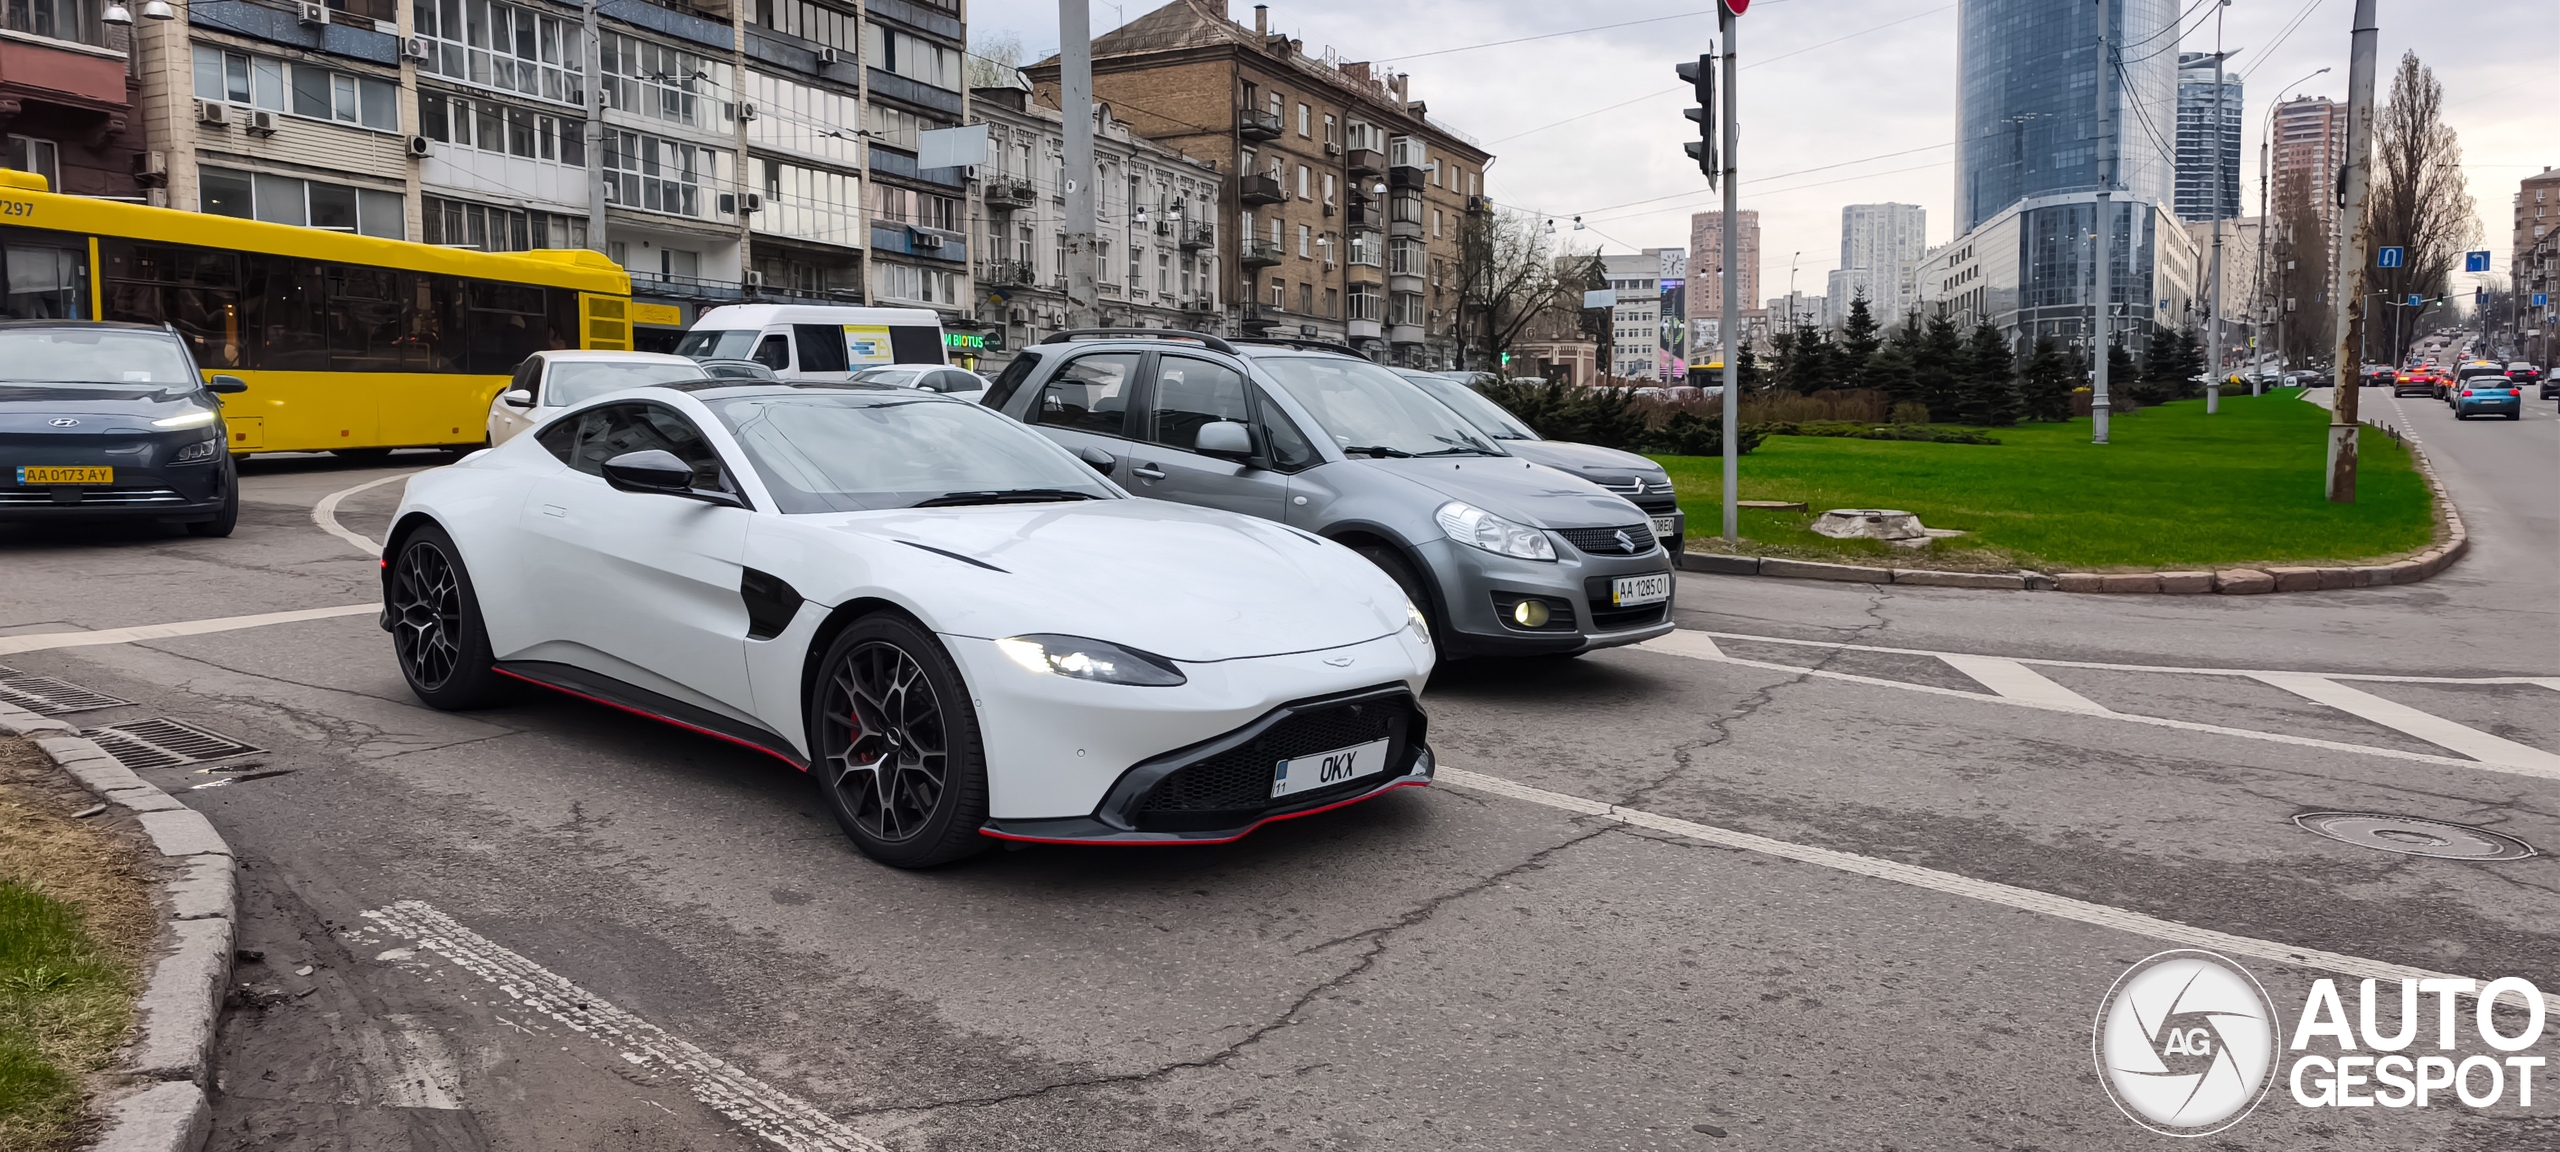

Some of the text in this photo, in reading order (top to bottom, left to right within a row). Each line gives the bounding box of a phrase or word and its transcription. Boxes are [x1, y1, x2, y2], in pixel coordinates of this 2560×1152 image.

[0, 200, 34, 217] 297
[953, 334, 983, 348] BIOTUS
[27, 469, 48, 481] AA
[51, 469, 84, 481] 0173
[88, 469, 107, 481] AY
[1620, 581, 1634, 599] AA
[1636, 579, 1655, 597] 1285
[1275, 782, 1286, 794] 11
